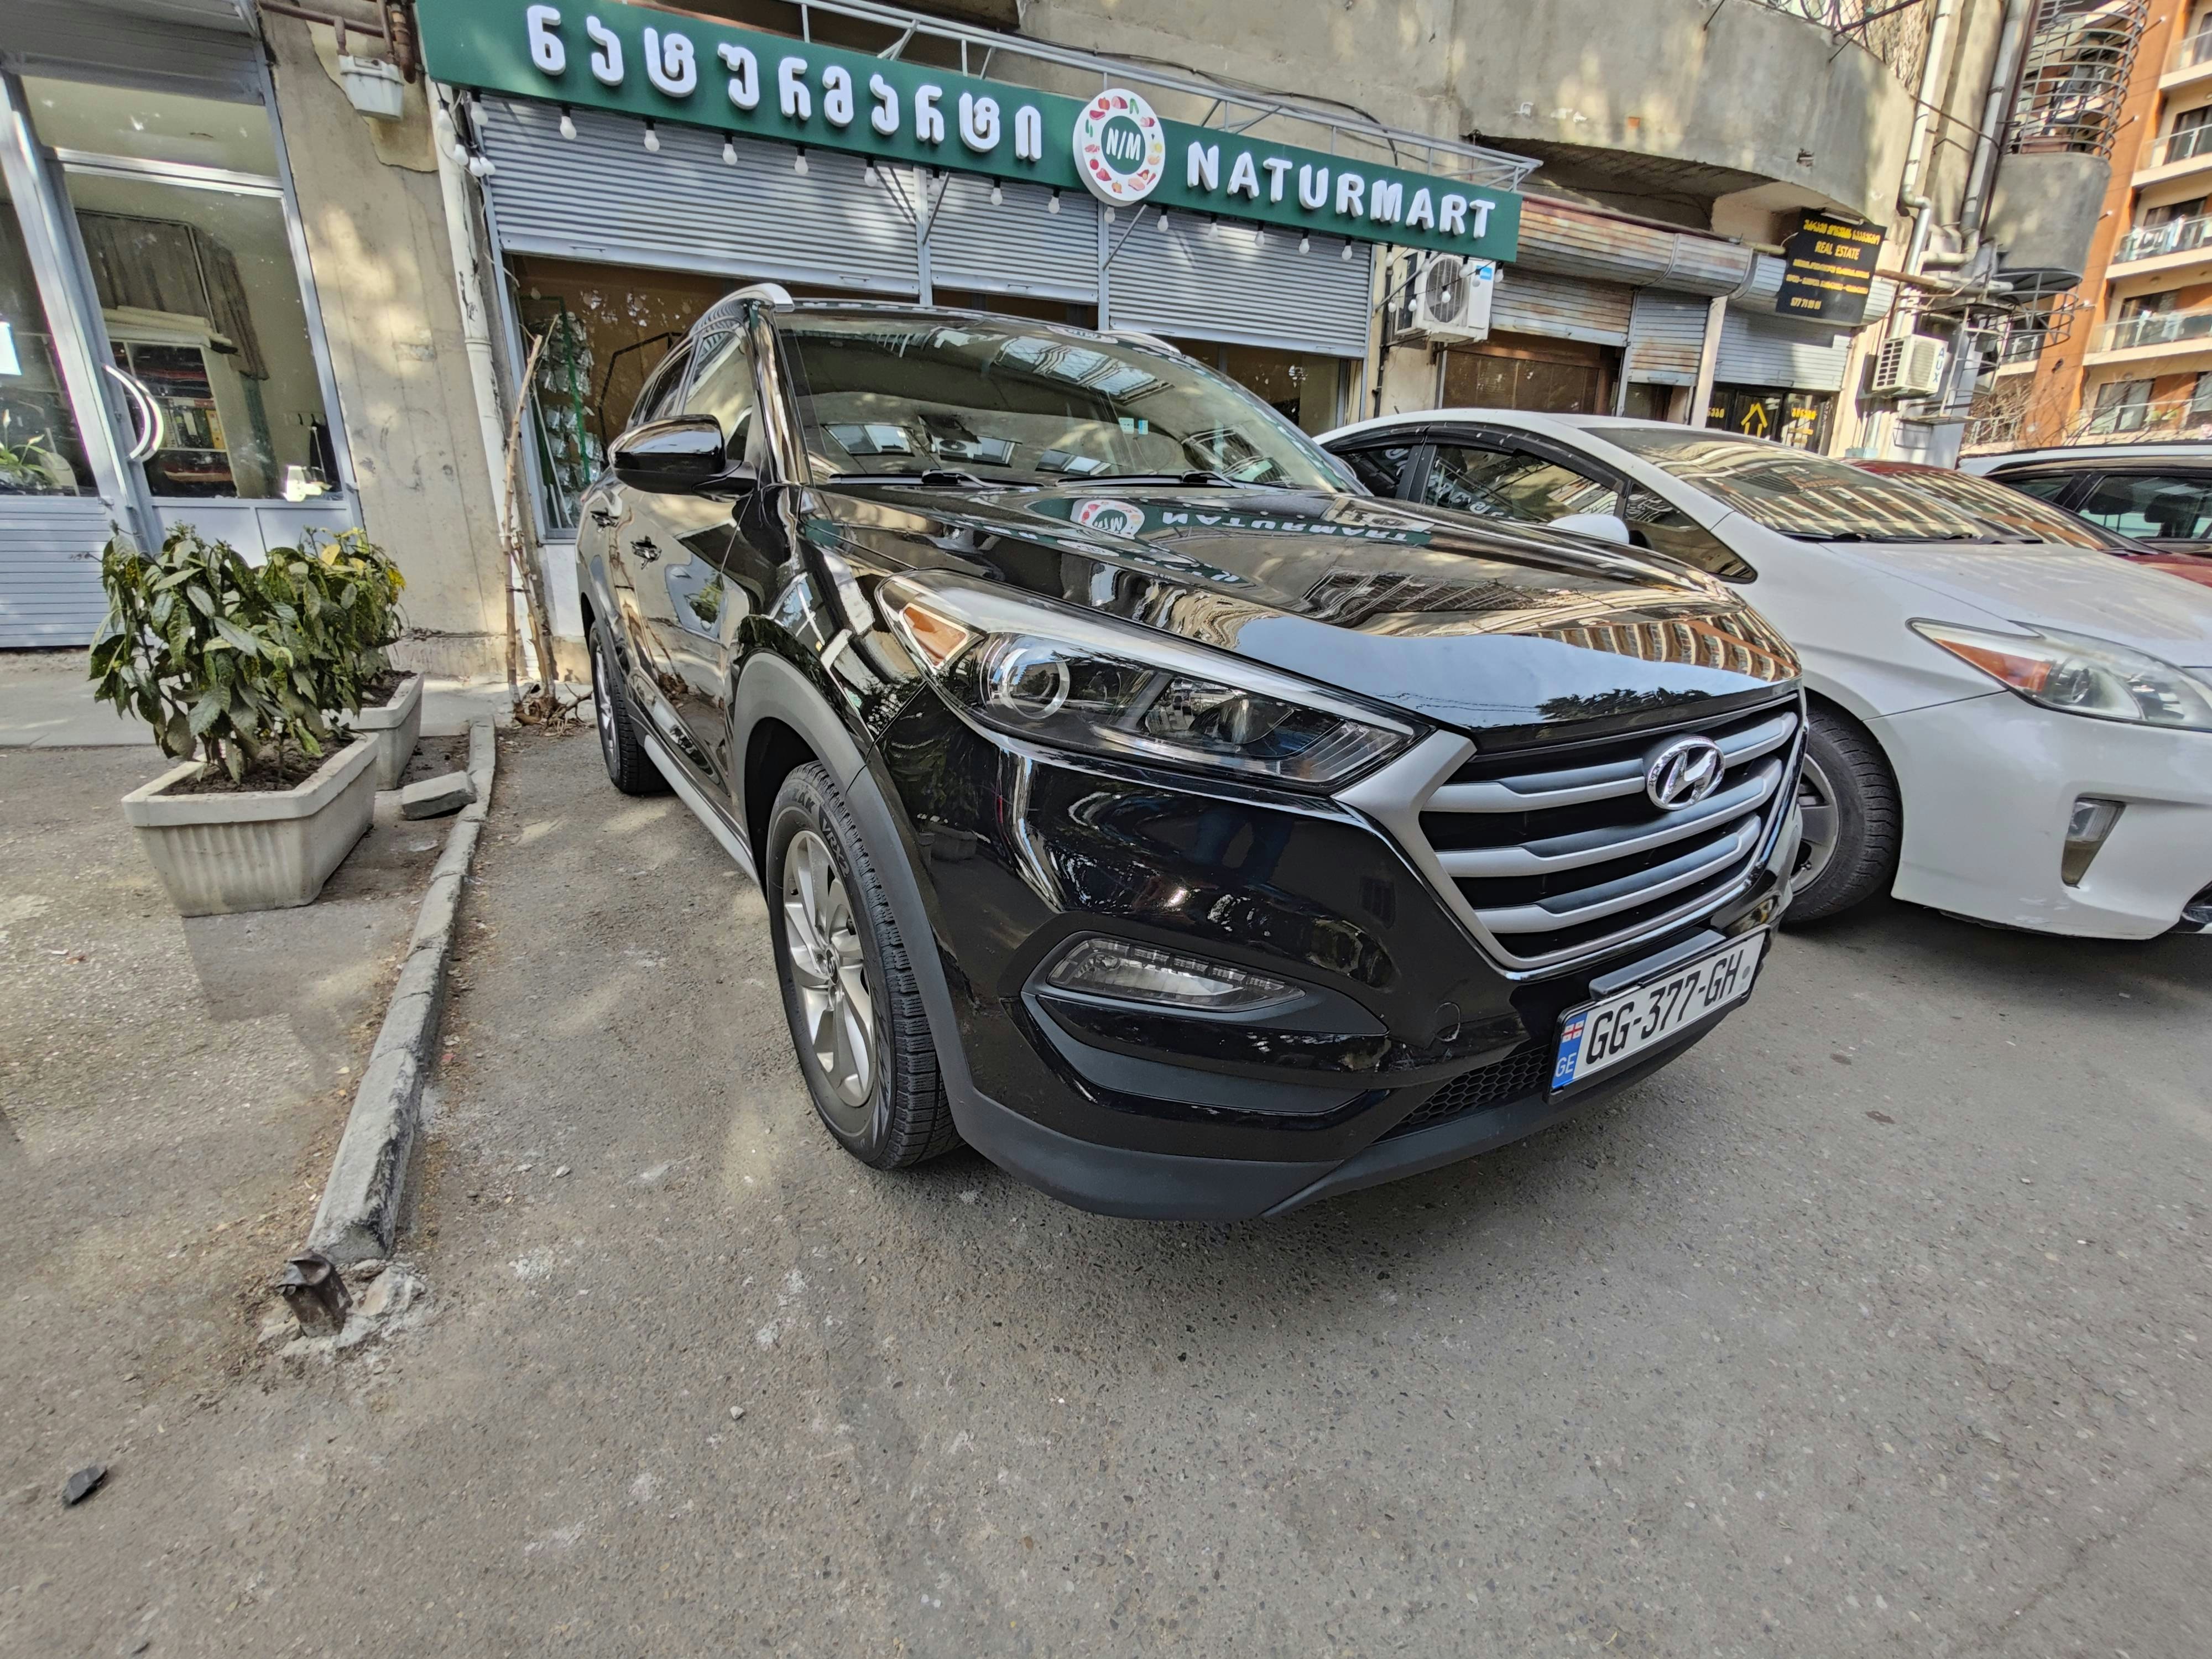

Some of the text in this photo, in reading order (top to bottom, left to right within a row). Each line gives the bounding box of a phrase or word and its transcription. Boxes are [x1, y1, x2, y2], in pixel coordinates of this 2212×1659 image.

[526, 4, 1042, 163] ნატურმარტი
[1187, 141, 1496, 239] NATURMART
[1815, 241, 1860, 260] REAL ESTATE
[1933, 347, 1944, 383] AUX
[822, 817, 850, 878] VRX2
[1585, 949, 1744, 1065] GG-377-GH
[1554, 1052, 1577, 1078] GE
